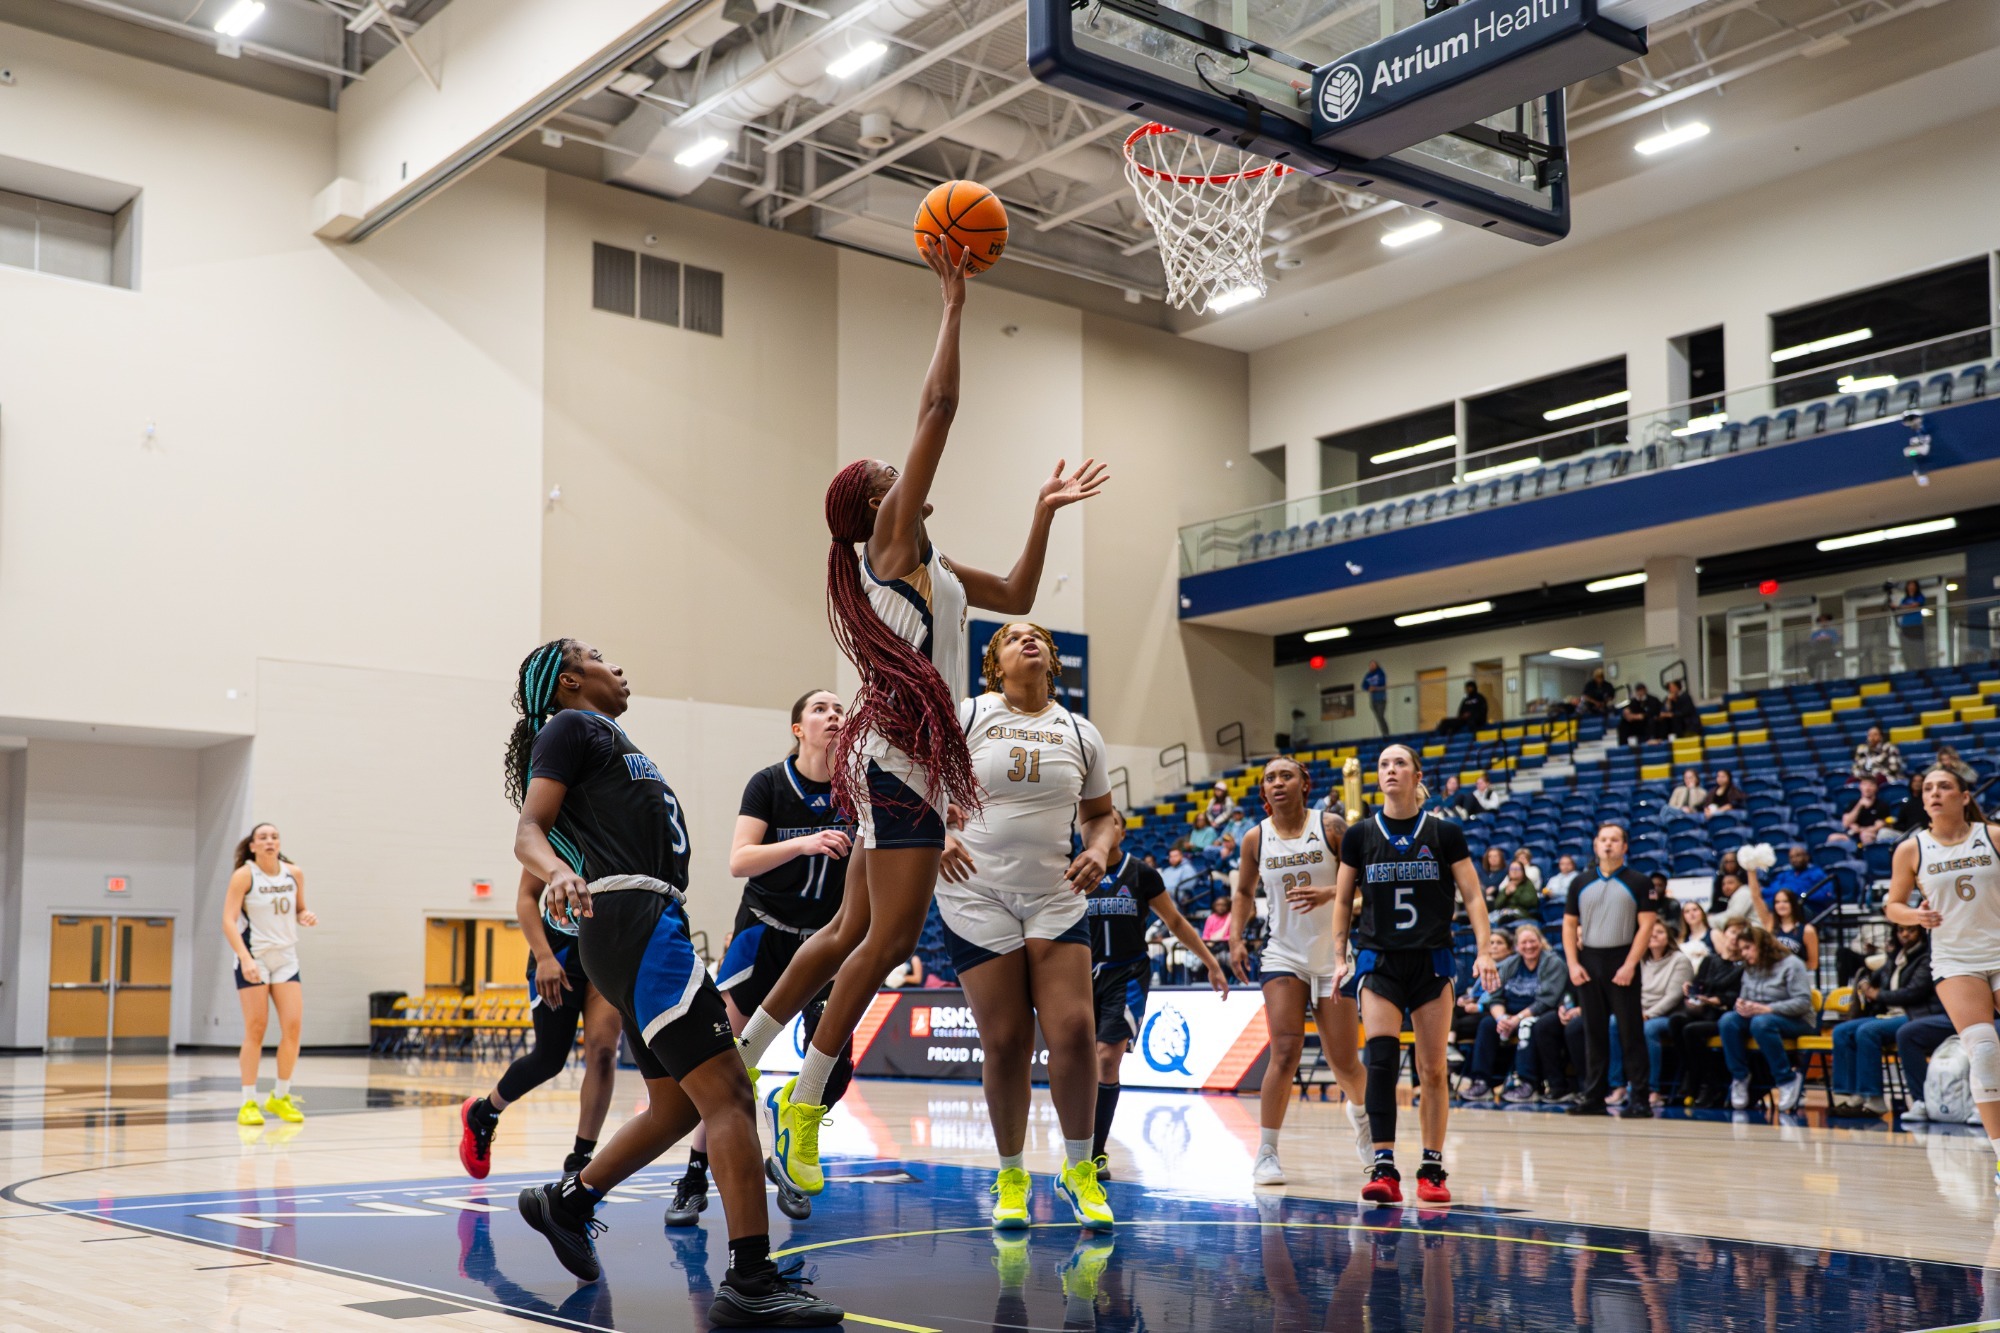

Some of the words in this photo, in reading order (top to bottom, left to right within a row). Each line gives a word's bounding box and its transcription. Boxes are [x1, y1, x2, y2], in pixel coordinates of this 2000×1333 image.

[1371, 32, 1469, 94] Atrium
[986, 725, 1063, 744] QUEENS
[1007, 747, 1041, 783] 31
[663, 792, 687, 854] 3
[1265, 850, 1323, 869] QUEENS
[1927, 855, 1992, 875] QUEENS
[800, 856, 830, 899] 11
[1366, 862, 1396, 884] WEST
[1396, 861, 1439, 881] GEORGIA
[1955, 875, 1976, 901] 6
[271, 897, 290, 915] 10
[1100, 897, 1138, 916] GEORGIA
[1394, 887, 1418, 930] 5
[1104, 920, 1111, 956] 1
[927, 1046, 970, 1062] PROUD
